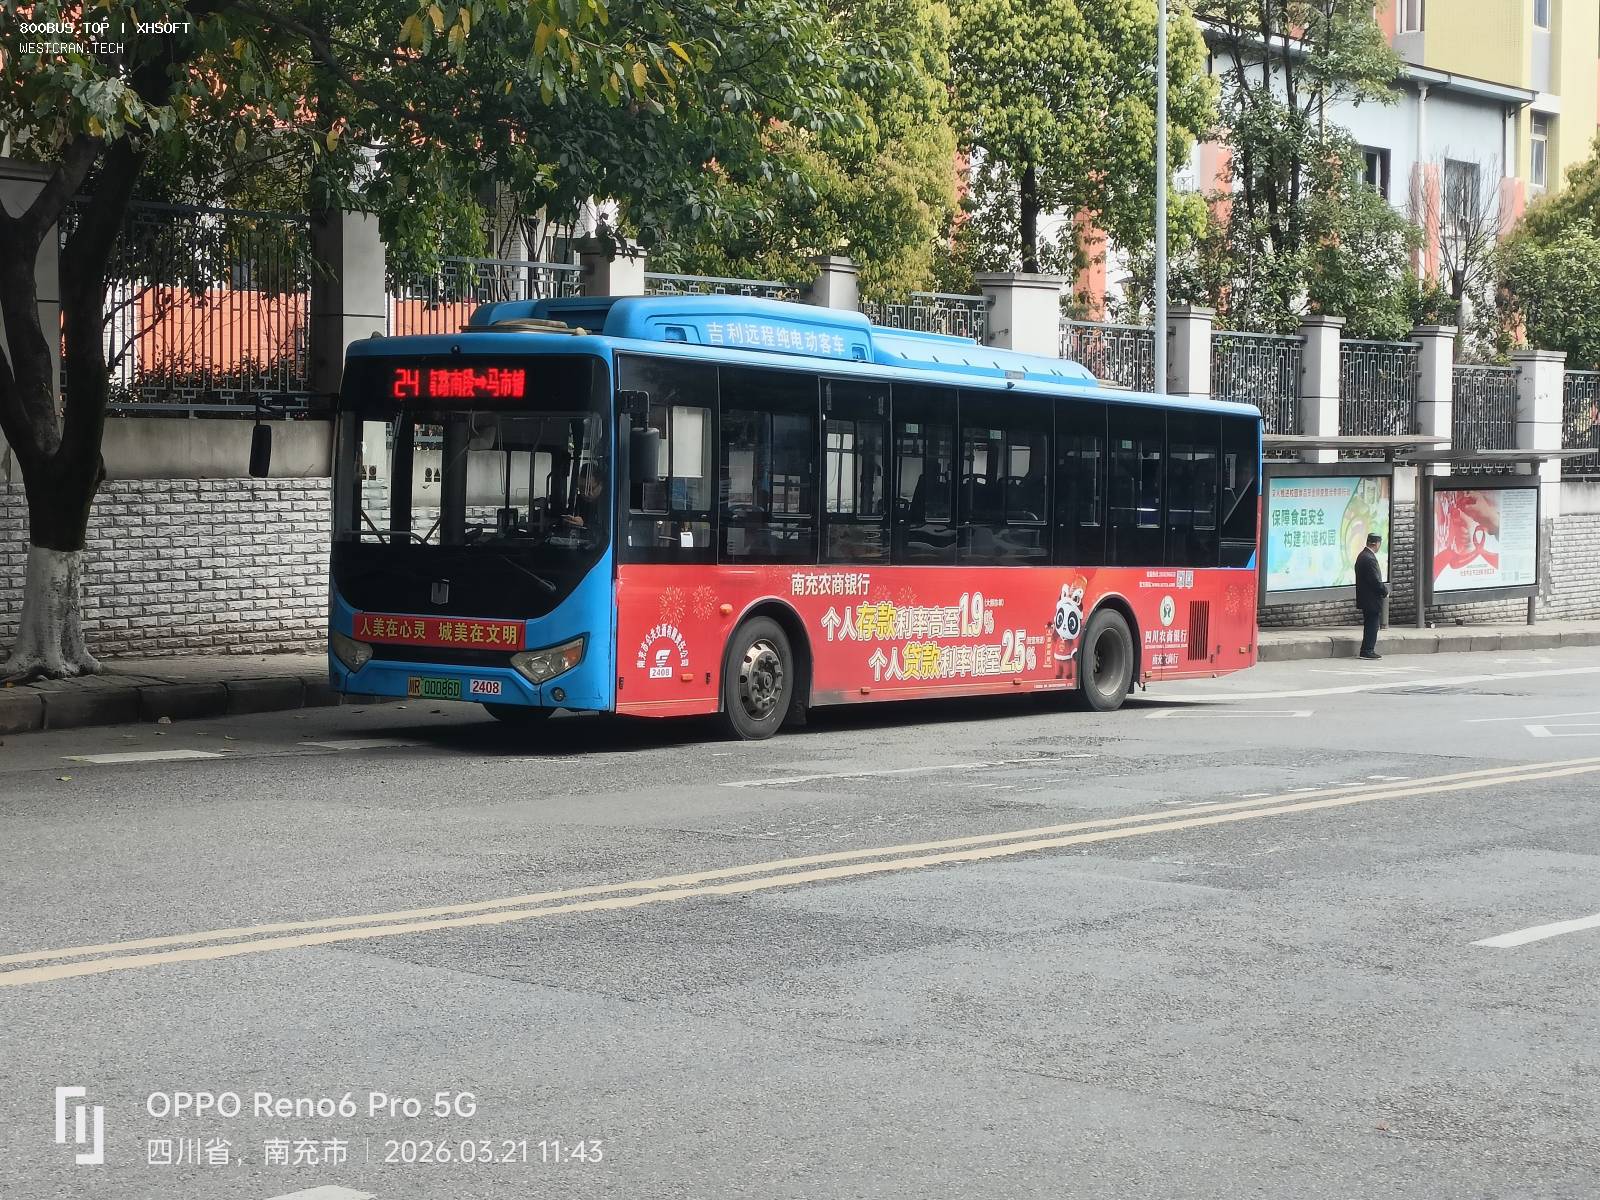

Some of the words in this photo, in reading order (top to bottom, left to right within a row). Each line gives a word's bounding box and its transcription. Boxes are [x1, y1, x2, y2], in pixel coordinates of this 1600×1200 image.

[706, 321, 846, 355] 吉利远程纯电动客车
[393, 368, 420, 397] 24
[1272, 508, 1325, 527] 保障食品安全
[1283, 529, 1337, 548] 构建和谐校园
[791, 572, 870, 596] 南充农商银行
[820, 592, 995, 641] 个人存款利率高至1.9%
[359, 616, 427, 640] 人美在心灵
[438, 622, 518, 645] 城美在文明
[868, 629, 1037, 681] 个人贷款利率低至2.5%
[651, 668, 671, 677] 2408
[472, 680, 499, 694] 2408
